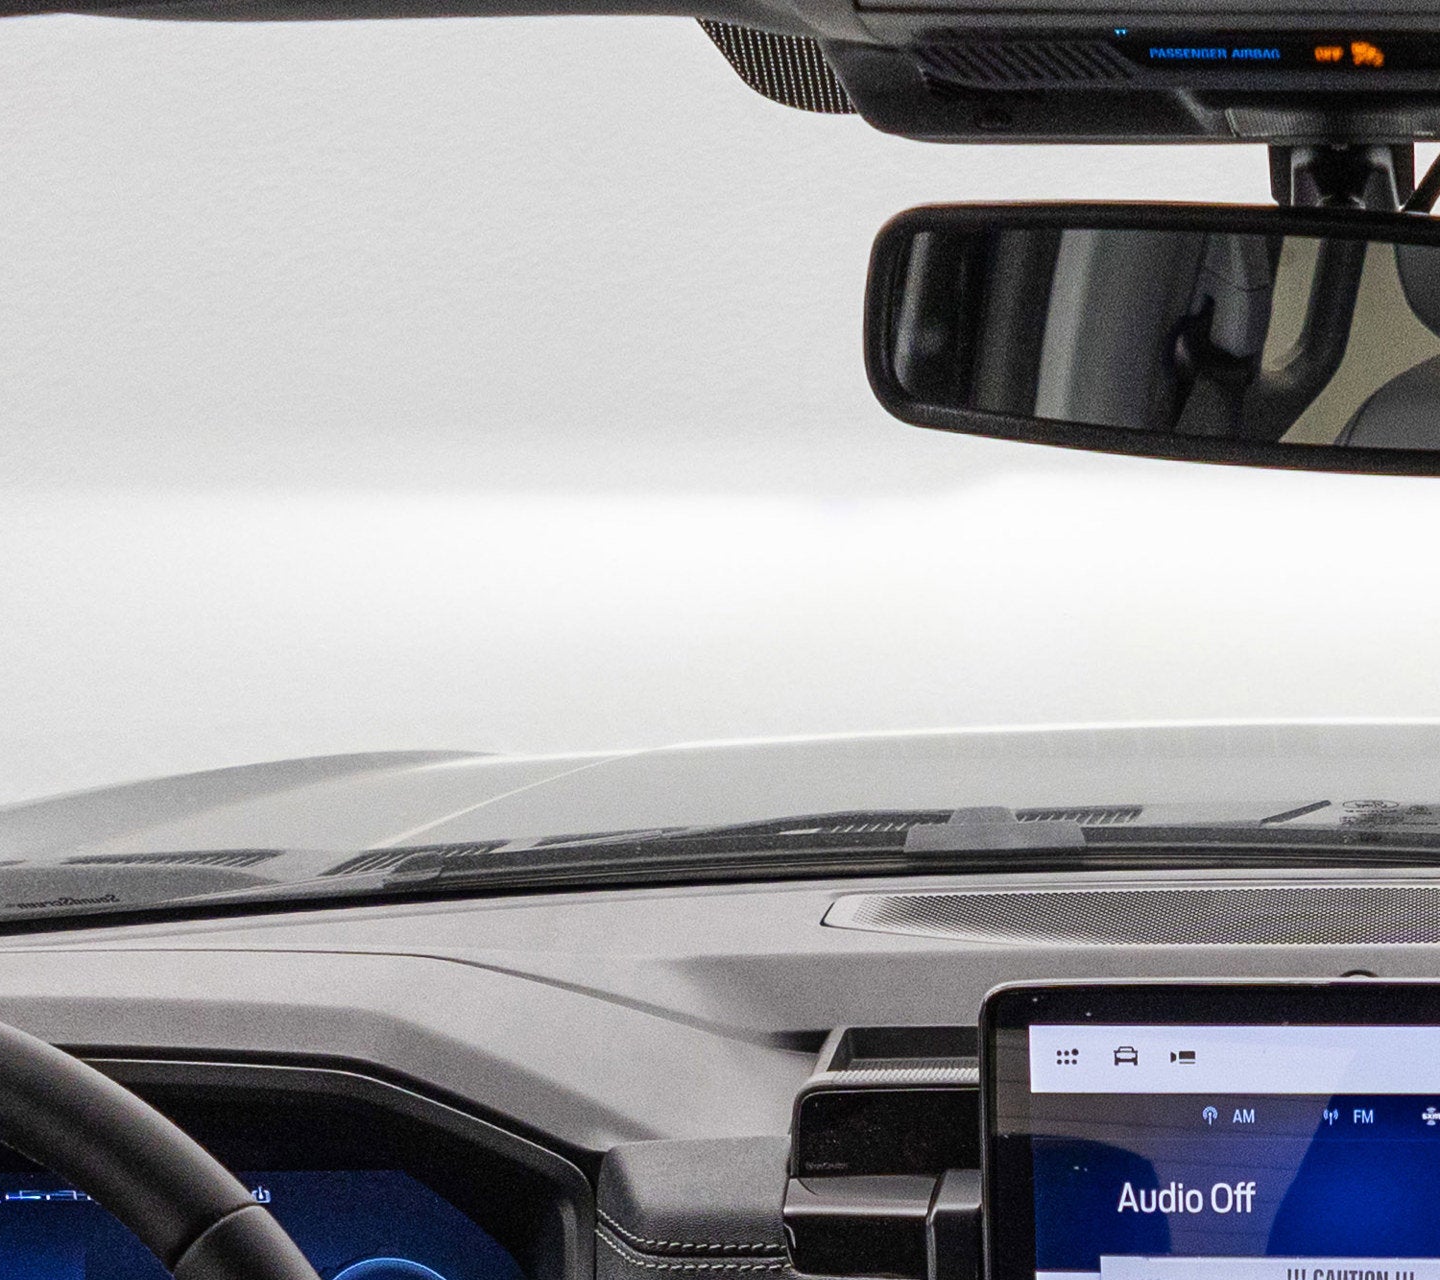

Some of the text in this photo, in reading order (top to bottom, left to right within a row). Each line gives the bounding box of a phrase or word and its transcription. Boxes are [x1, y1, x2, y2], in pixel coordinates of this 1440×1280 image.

[1233, 1109, 1255, 1124] AM
[1353, 1109, 1374, 1124] FM
[1117, 1181, 1257, 1214] Audio Off
